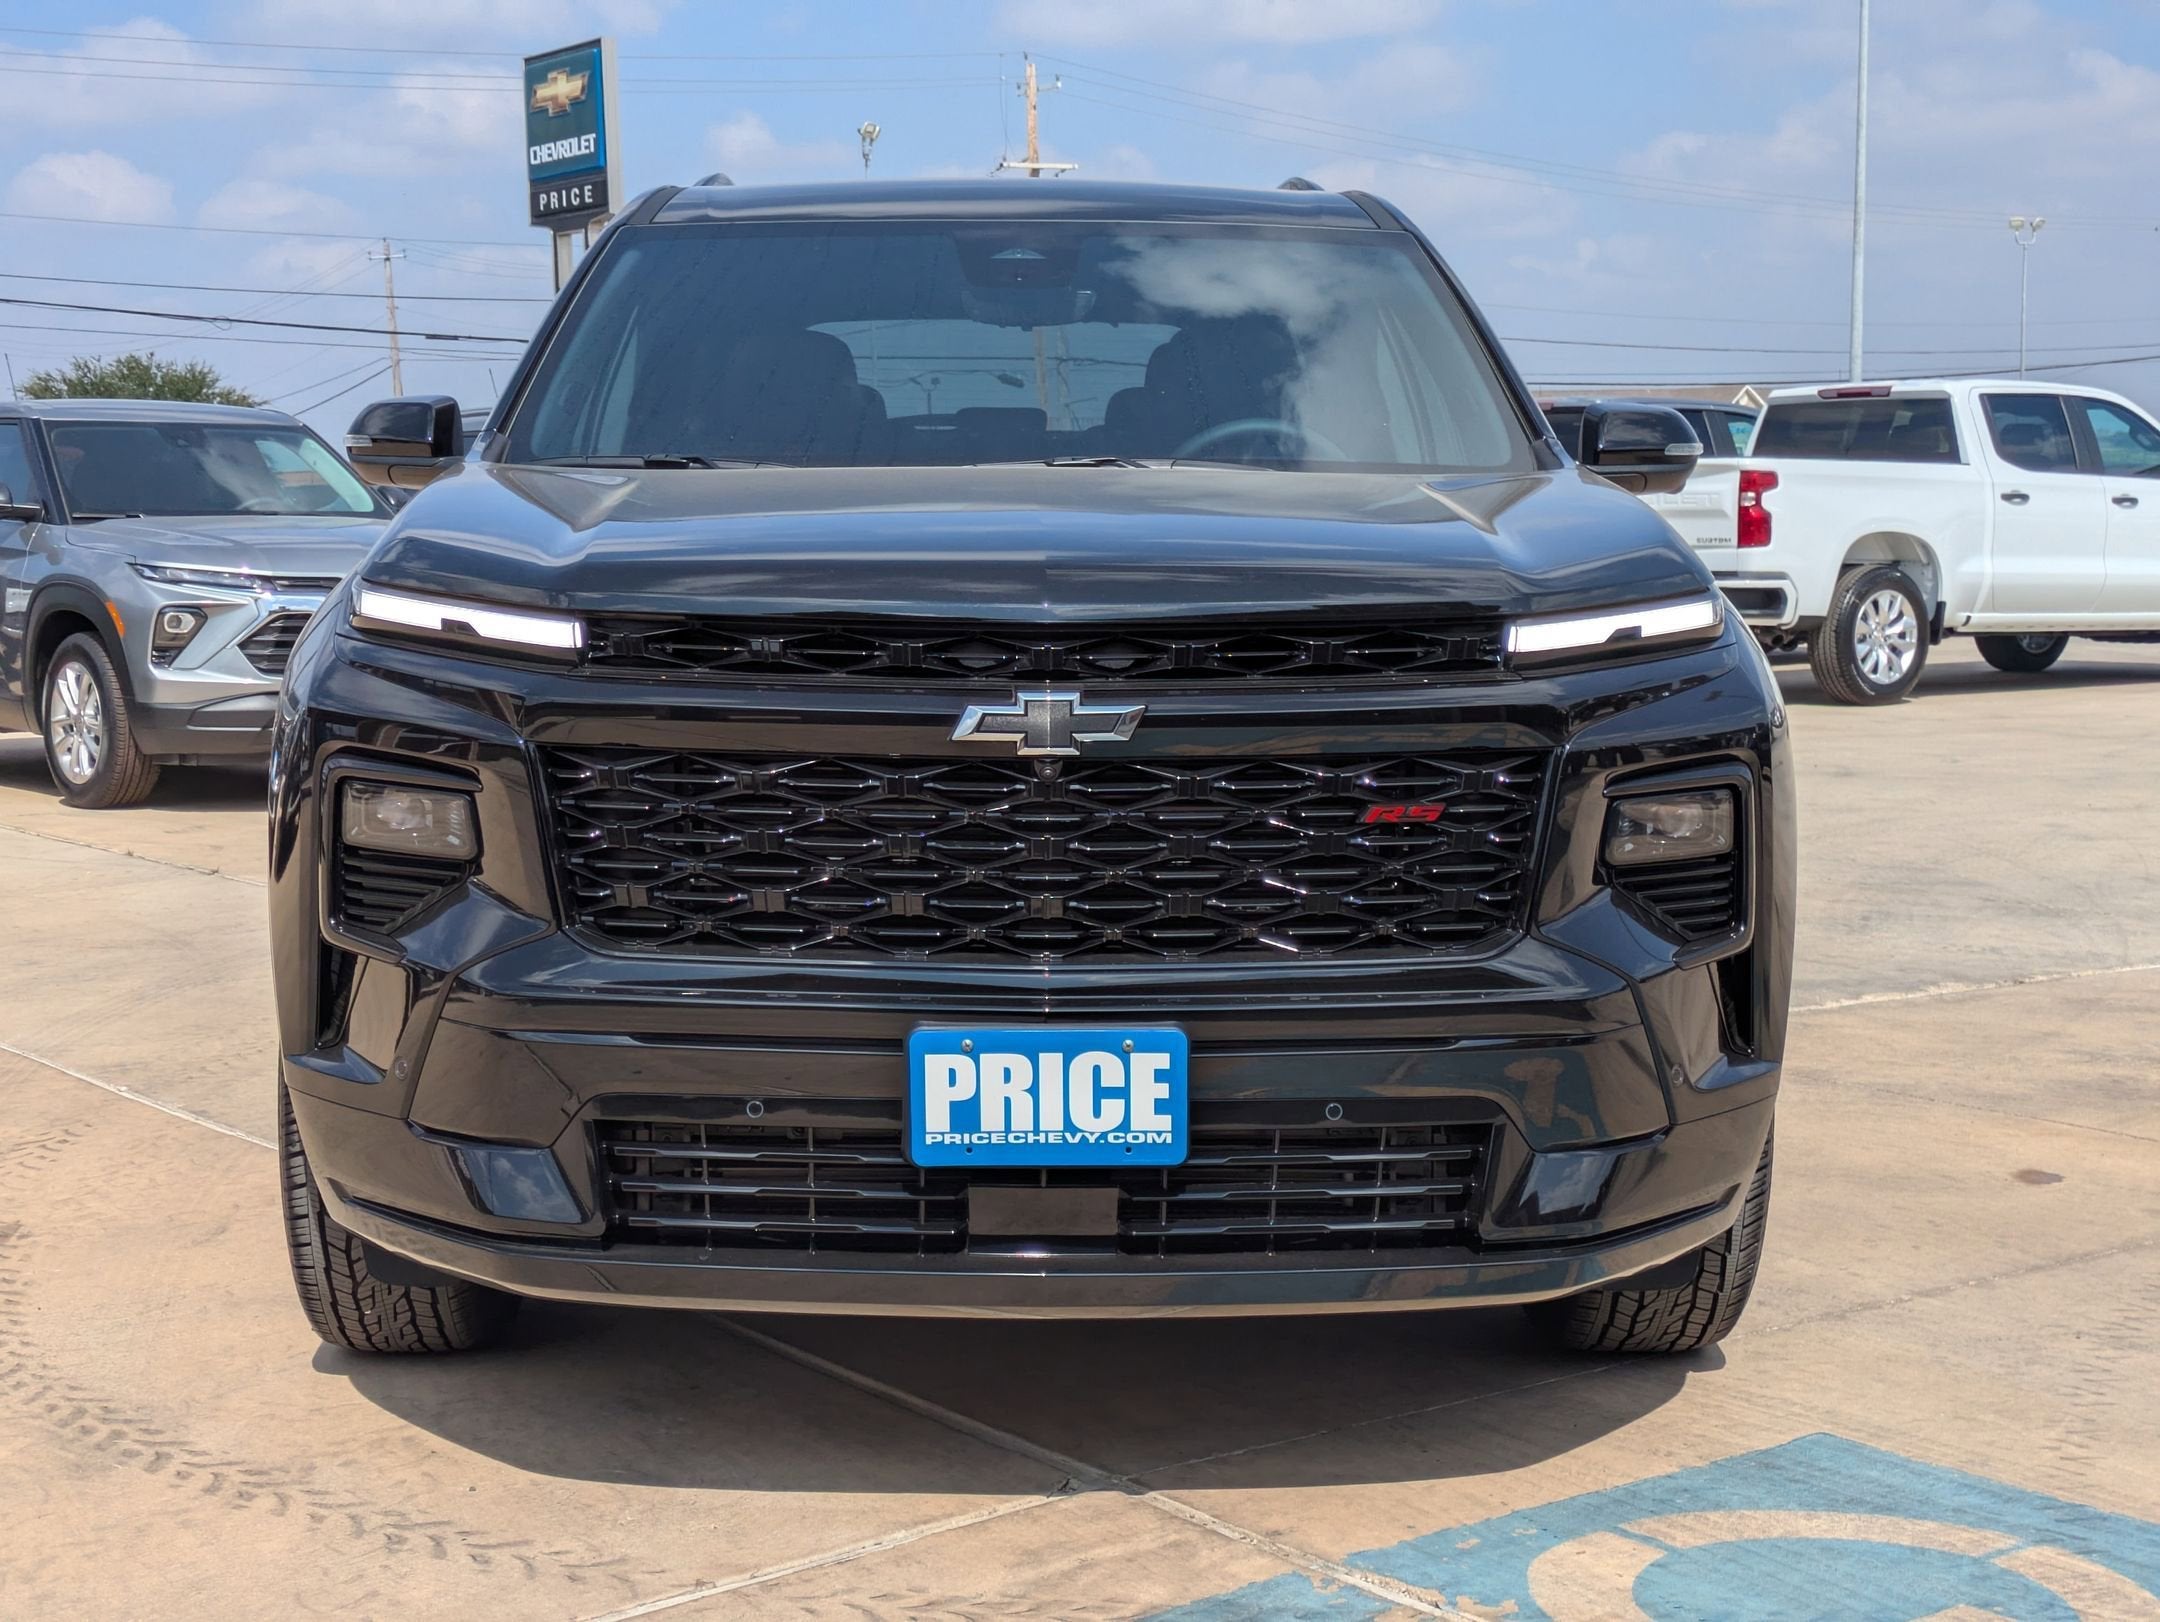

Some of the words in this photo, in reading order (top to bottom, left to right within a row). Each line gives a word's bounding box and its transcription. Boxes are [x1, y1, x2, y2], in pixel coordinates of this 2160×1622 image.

[530, 133, 596, 165] CHEVROLET
[539, 185, 593, 212] PRICE
[1363, 803, 1446, 823] RS
[924, 1051, 1173, 1132] PRICE
[925, 1132, 1173, 1145] PRICECHEVY.COM
